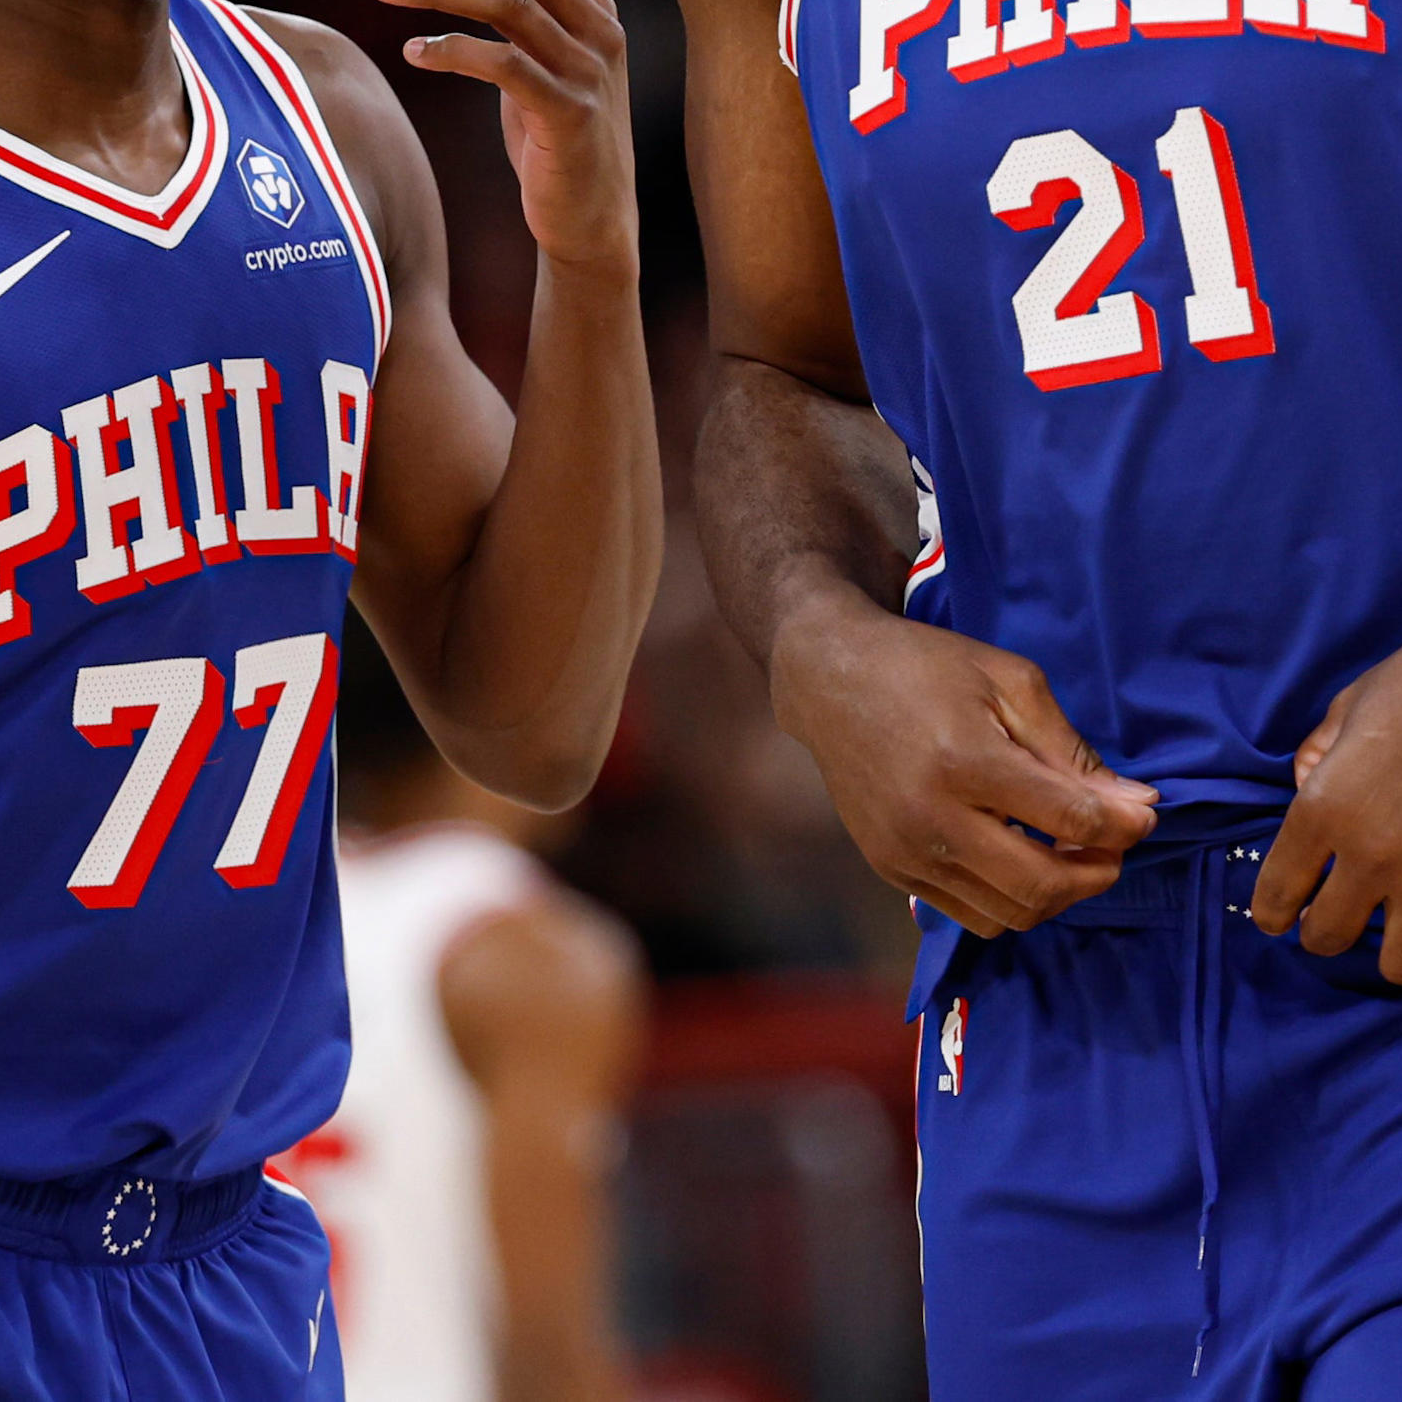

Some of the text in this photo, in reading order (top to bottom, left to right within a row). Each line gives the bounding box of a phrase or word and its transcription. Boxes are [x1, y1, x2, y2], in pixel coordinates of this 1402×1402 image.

[245, 237, 347, 272] crypto.com
[986, 106, 1275, 392] 21
[67, 632, 339, 909] 77
